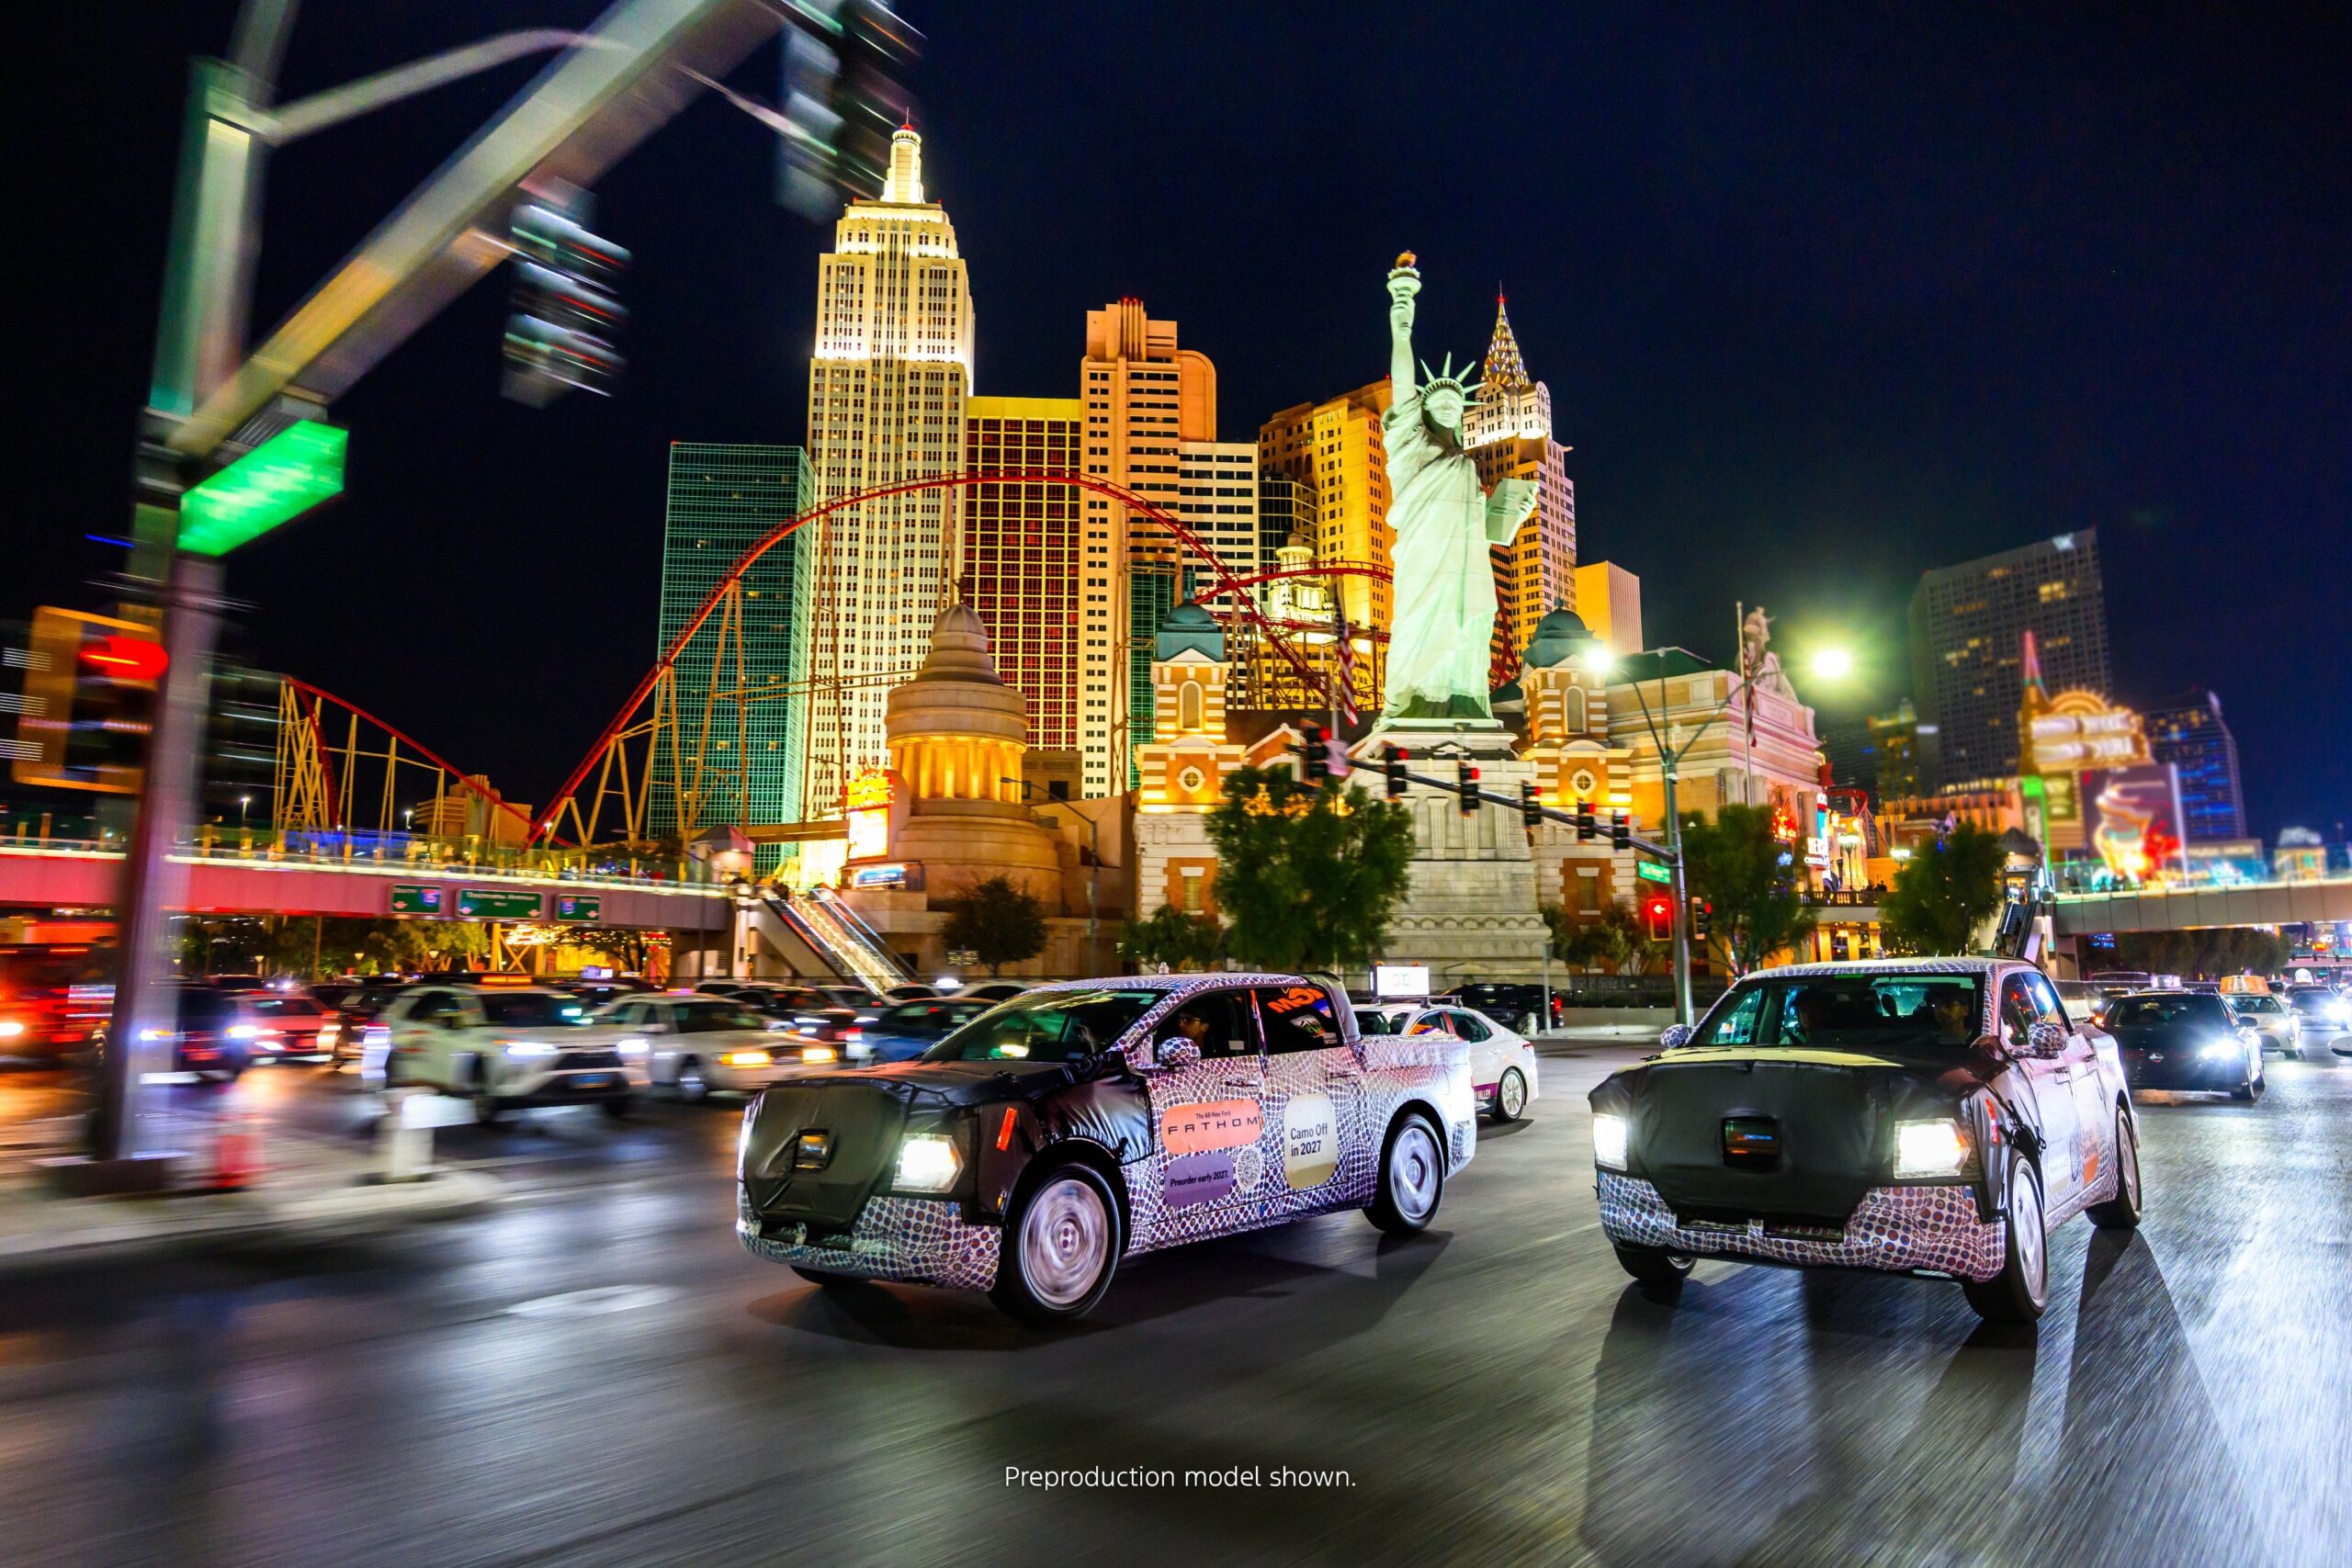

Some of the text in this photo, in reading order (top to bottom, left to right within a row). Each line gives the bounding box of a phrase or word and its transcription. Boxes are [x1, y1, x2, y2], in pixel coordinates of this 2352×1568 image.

[1168, 1116, 1258, 1135] FATHOM
[1291, 1122, 1328, 1140] Camo Off
[1291, 1140, 1321, 1156] in 2027
[1170, 1170, 1229, 1187] Preorder early 2027.
